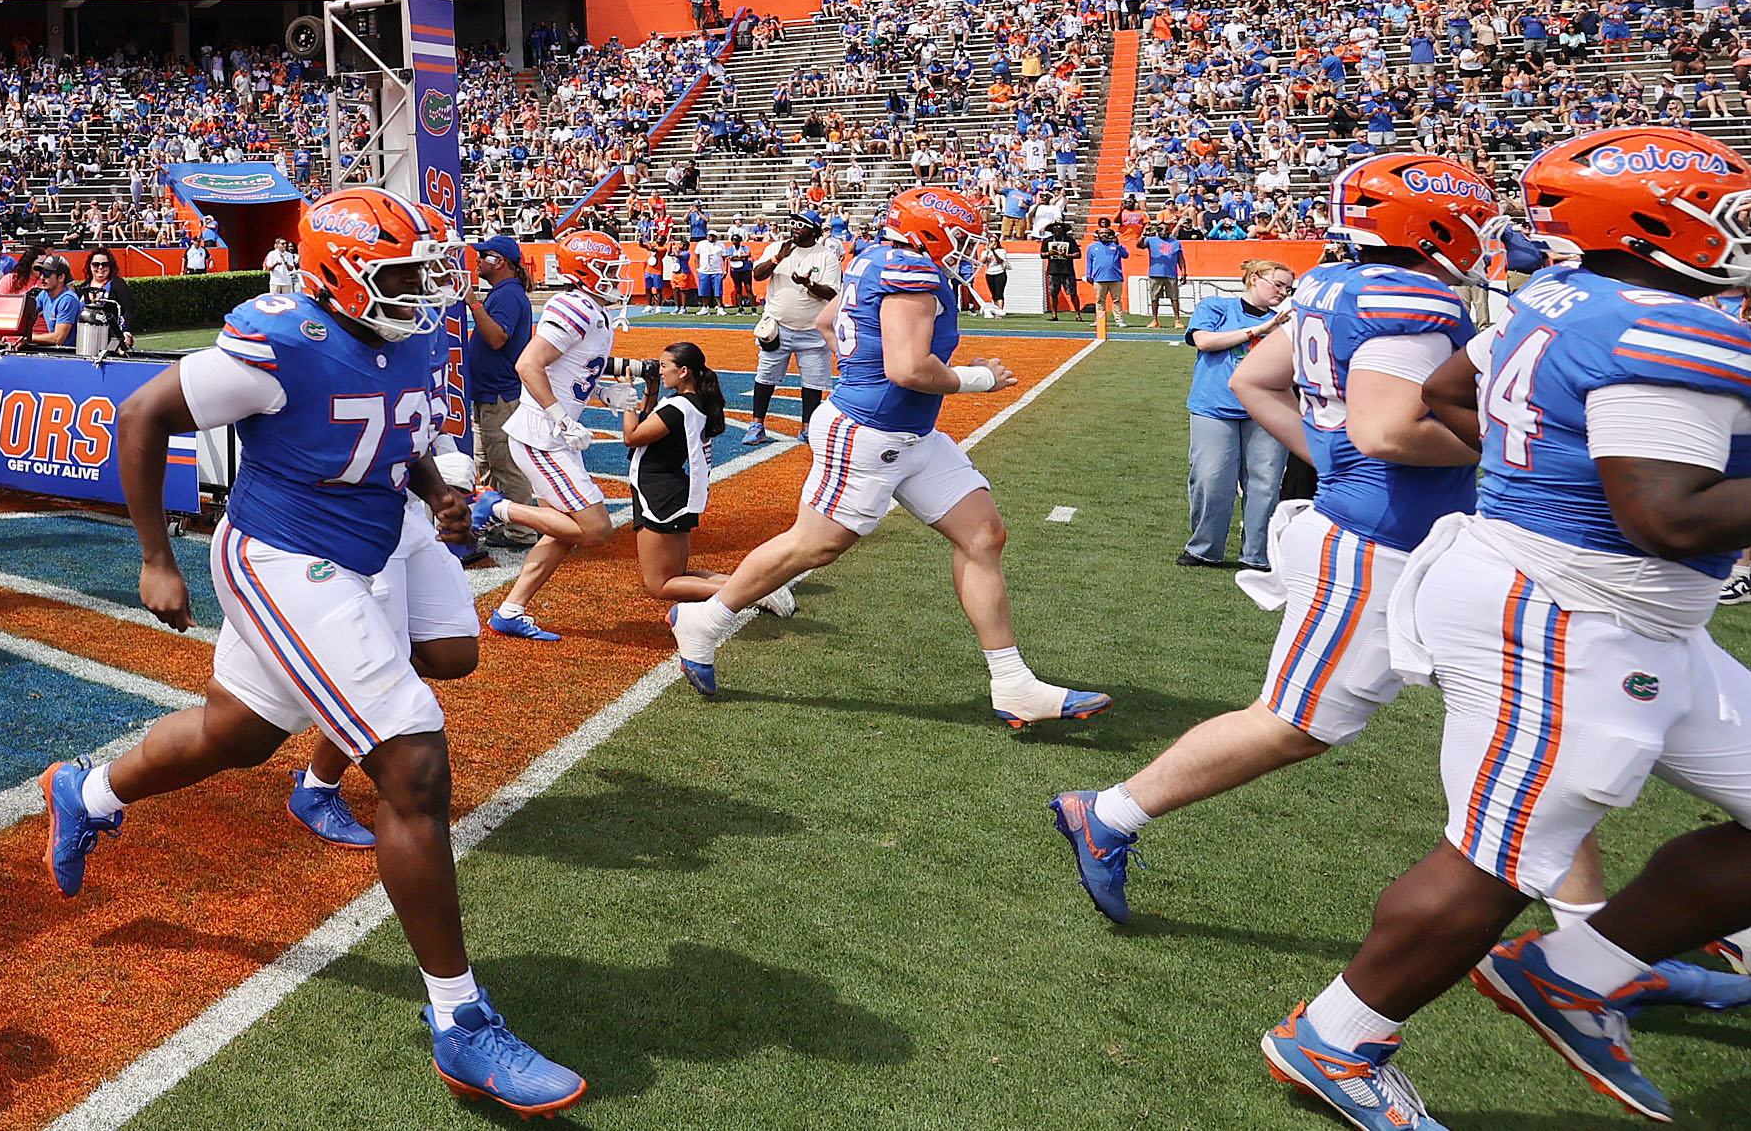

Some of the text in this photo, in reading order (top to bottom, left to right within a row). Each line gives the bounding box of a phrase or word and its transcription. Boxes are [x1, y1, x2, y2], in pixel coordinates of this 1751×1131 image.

[1590, 144, 1730, 178] Gators
[1403, 169, 1492, 203] Gators
[312, 205, 380, 245] Gators
[922, 193, 974, 224] Gators
[570, 237, 612, 255] Gators
[1292, 308, 1347, 431] 9
[316, 387, 431, 490] 73
[7, 458, 100, 481] GET OUT ALIVE
